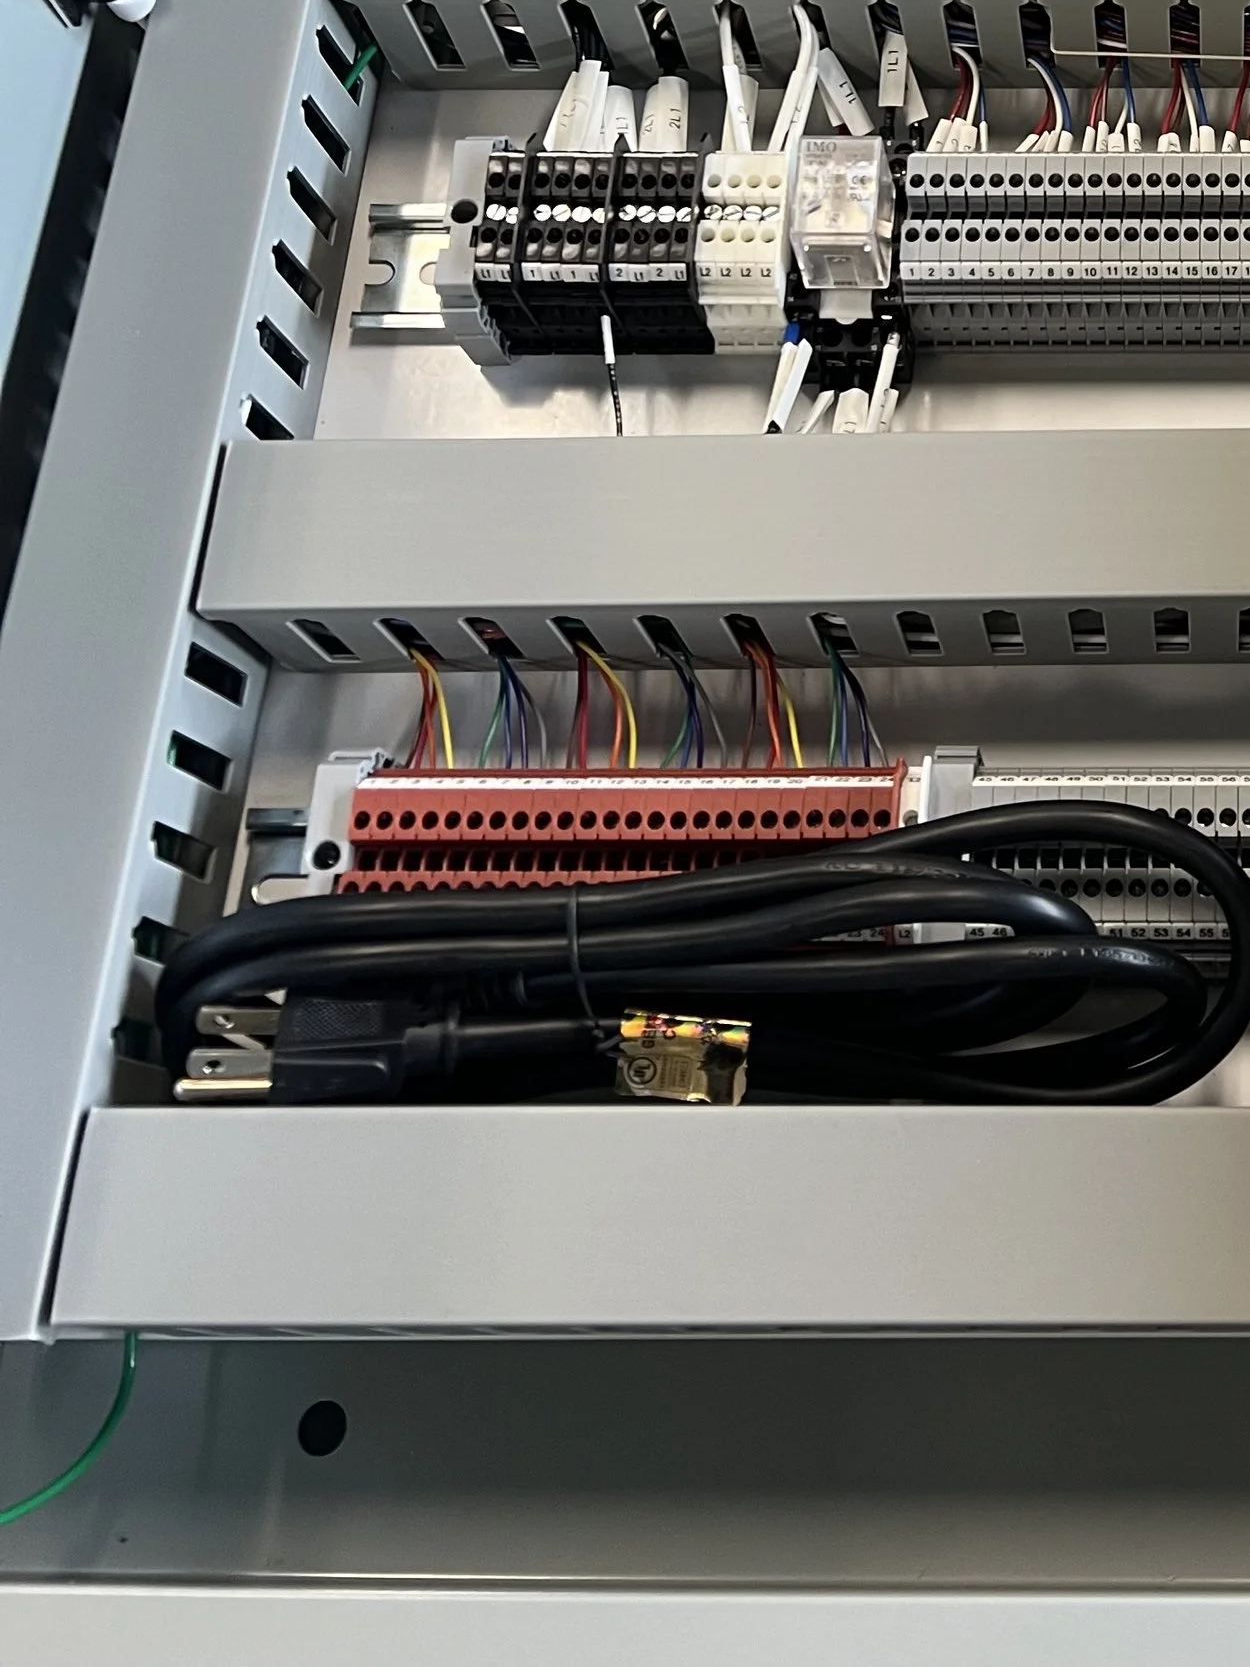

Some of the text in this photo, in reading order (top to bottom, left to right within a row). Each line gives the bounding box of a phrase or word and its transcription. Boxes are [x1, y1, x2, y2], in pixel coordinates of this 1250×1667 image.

[887, 50, 899, 73] 1L1
[839, 80, 857, 105] 1L1
[669, 108, 681, 129] 2L1
[806, 141, 837, 153] IMO
[616, 267, 663, 277] 2 2
[700, 267, 772, 277] L2 L2 L2 L2
[928, 268, 935, 277] 2
[948, 268, 955, 277] 3
[969, 268, 976, 277] 4
[988, 268, 995, 277] 5
[1008, 268, 1015, 277] 6
[1028, 268, 1035, 277] 7
[1047, 268, 1054, 277] 8
[1067, 268, 1074, 277] 9
[1085, 268, 1097, 277] 10
[1107, 267, 1118, 276] 11
[1126, 267, 1138, 276] 12
[1146, 267, 1158, 276] 13
[1166, 267, 1178, 276] 14
[1186, 267, 1198, 276] 15
[1206, 267, 1218, 276] 16
[1226, 267, 1238, 276] 17
[971, 927, 1008, 937] 45 46
[1131, 929, 1146, 938] 52
[1154, 929, 1169, 938] 53
[1176, 929, 1191, 938] 54
[1199, 929, 1214, 938] 55
